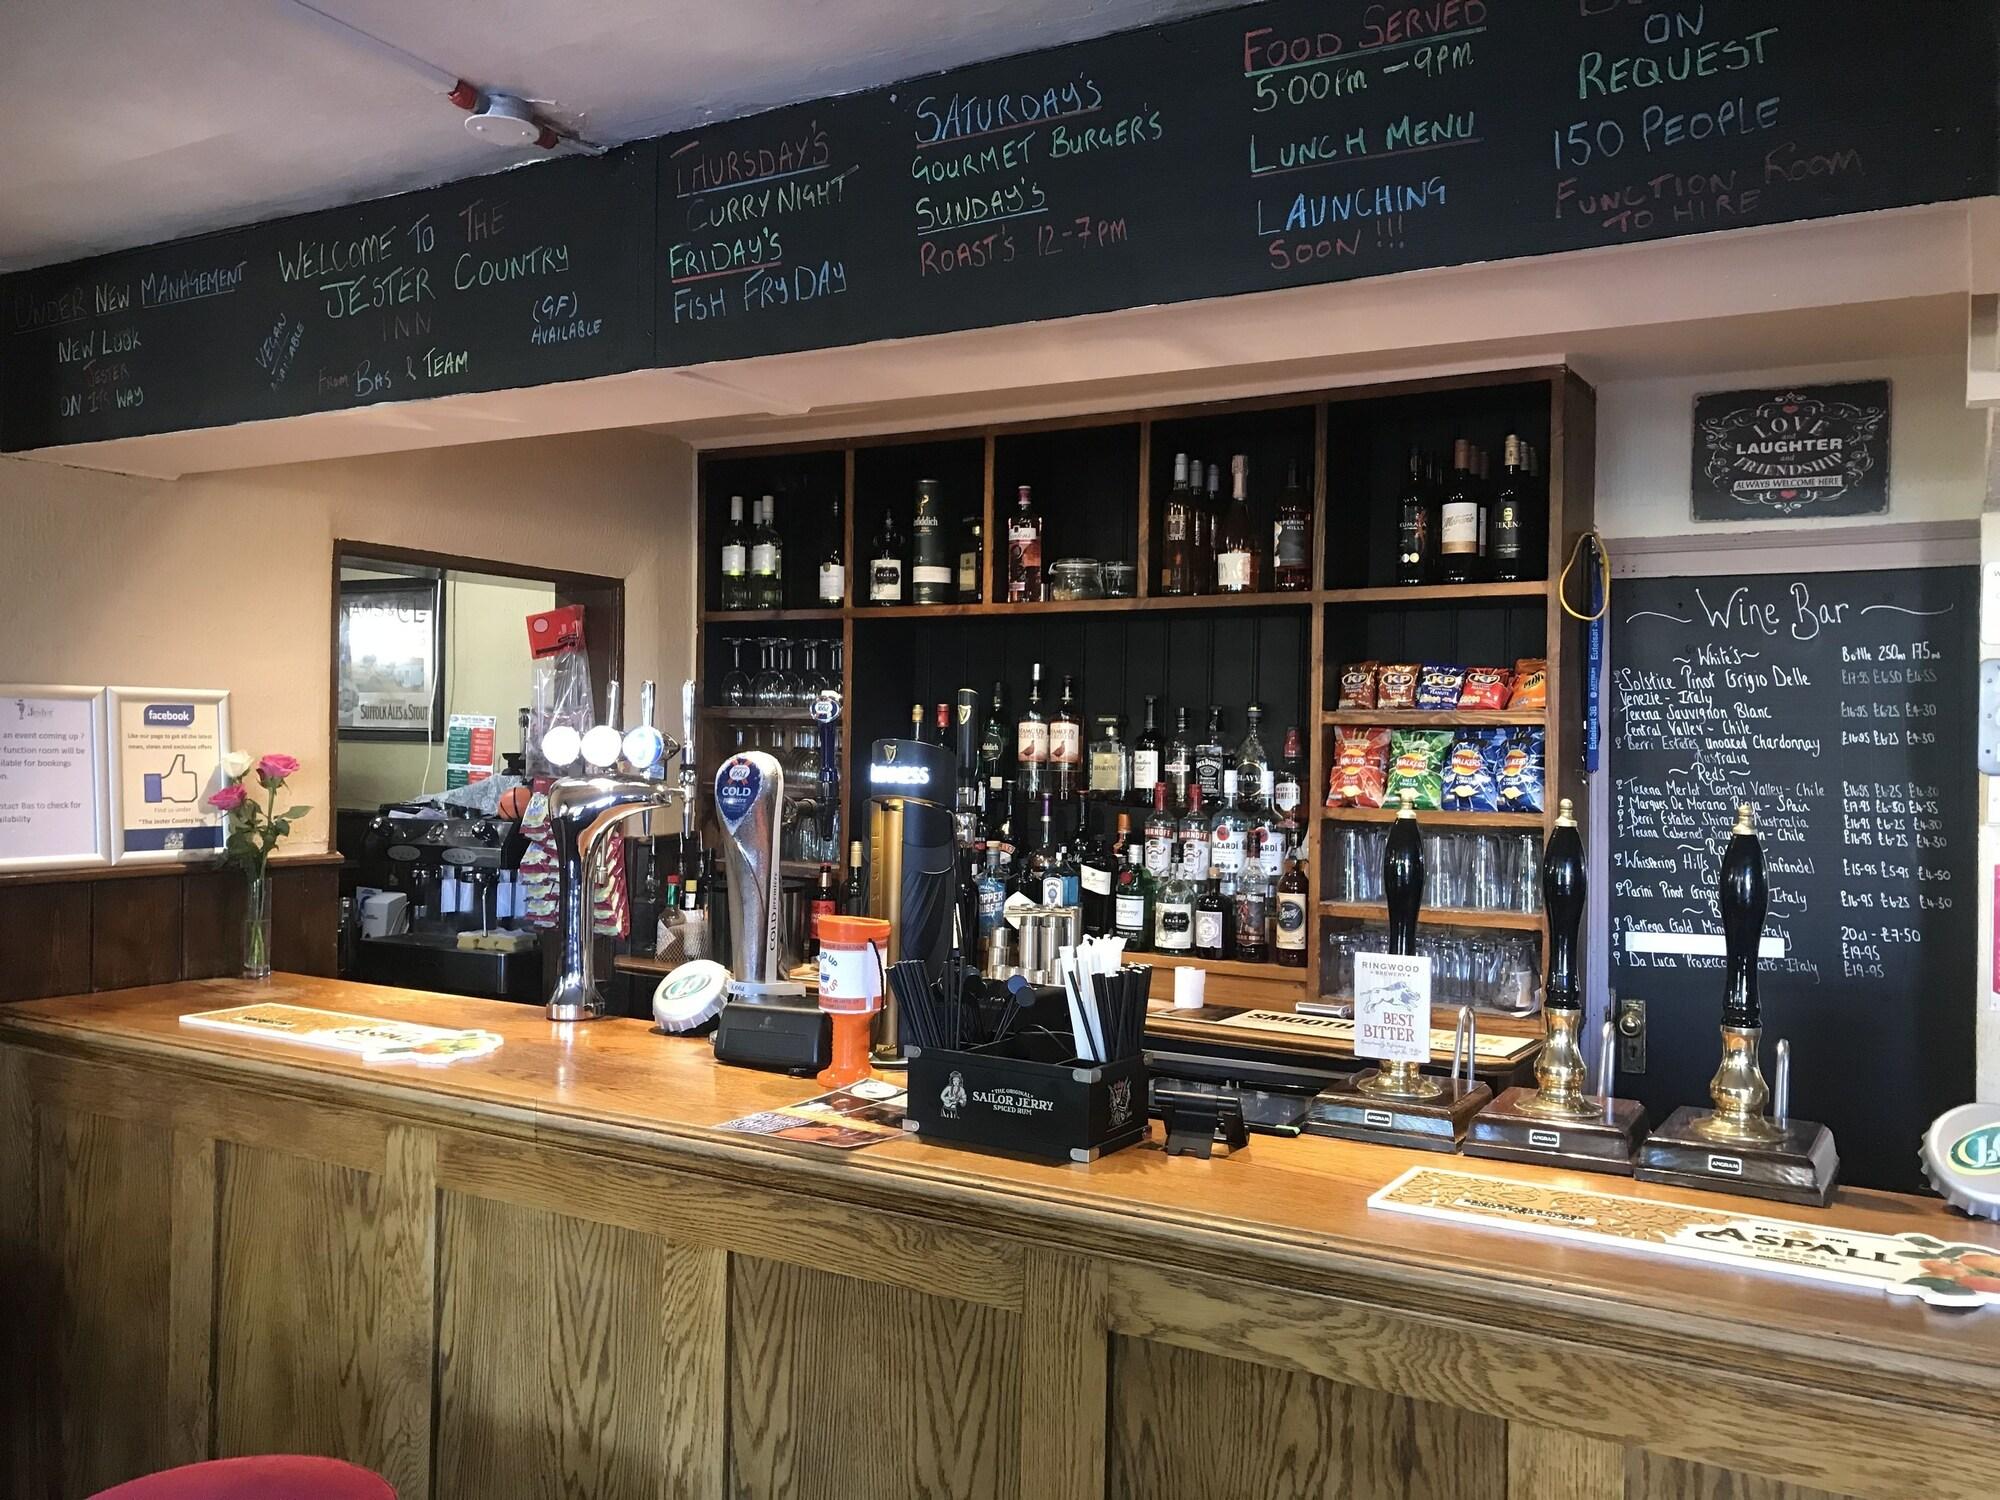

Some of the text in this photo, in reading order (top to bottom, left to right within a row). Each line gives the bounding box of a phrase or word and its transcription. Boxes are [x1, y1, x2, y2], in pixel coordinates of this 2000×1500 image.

[1244, 0, 1487, 73] FOOD SERVED
[1644, 3, 1704, 44] ON
[1578, 27, 1779, 100] REQUEST
[915, 72, 1102, 143] SATURDAY'S
[912, 102, 1163, 184] GOURMET BURGER'S
[1250, 111, 1474, 173] LUNCH MENU
[1554, 97, 1780, 170] 150 PEOPLE
[1555, 141, 1867, 219] FUNCTION ROOM
[687, 164, 859, 231] CURRY NIGHT
[916, 176, 1045, 230] SUNDAY'S
[1257, 176, 1446, 236] LAUNCHING
[1601, 189, 1761, 233] TO HIRE
[278, 199, 507, 282] WELCOME TO THE
[669, 226, 782, 278] FRIDAY'S
[1268, 229, 1361, 270] SOON
[95, 284, 130, 313] NEW
[141, 261, 247, 305] MANAGEMENT
[320, 244, 569, 319] JESTER COUNTRY
[672, 286, 726, 324] FISH
[382, 311, 432, 342] INN
[530, 318, 603, 346] AVAILABLE
[58, 326, 143, 363] NEW LOOK
[83, 358, 130, 387] JESTER
[354, 359, 393, 397] BAS
[422, 347, 470, 380] TEAM
[60, 386, 145, 417] ON WAY
[1753, 415, 1830, 439] LOVE
[1736, 438, 1843, 455] LAUGHTER
[1733, 452, 1842, 476] FRIENDSHIP
[1736, 477, 1839, 489] ALWAYS WELCOME HERE
[1695, 582, 1849, 641] Wine Bar
[1387, 674, 1411, 683] KP
[1432, 676, 1455, 686] KP
[1618, 665, 1811, 693] Solstice Pinot Grigio Delle
[360, 704, 387, 720] SUFFOLK
[388, 704, 403, 720] ALES
[408, 704, 429, 720] STOUT
[1666, 702, 1772, 724] Sauvignon Blanc
[1677, 690, 1713, 710] Italy
[148, 709, 190, 721] facebook
[1668, 720, 1703, 736] Valley
[1723, 721, 1752, 735] Chile
[1589, 719, 1597, 750] Eutelsat
[1753, 734, 1820, 757] Chardonnay
[722, 786, 751, 796] COLD
[1666, 778, 1825, 797] Merlot Central Valley Chile
[1629, 795, 1669, 811] Marques
[1687, 796, 1727, 810] Morano
[1661, 811, 1695, 826] Estates
[1663, 825, 1703, 839] Cabernet
[1778, 828, 1806, 842] Chile
[1683, 853, 1709, 870] Hills
[1766, 857, 1815, 874] infandel
[1659, 881, 1684, 898] Pinot
[1770, 887, 1807, 912] Italy
[769, 911, 778, 951] COLD
[1669, 918, 1693, 933] Gold
[1362, 961, 1420, 973] RINGWOOD
[1652, 953, 1677, 968] Luca
[1781, 958, 1820, 985] Italy
[1364, 1023, 1415, 1042] BITTER
[1383, 1011, 1415, 1027] BEST
[973, 1091, 1054, 1111] SAILOR JERRY
[1006, 1088, 1030, 1098] ORIGINAL
[993, 1104, 1016, 1113] SPICED
[1711, 1160, 1739, 1170] ANGRAM
[1696, 1226, 1901, 1266] ASPALL
